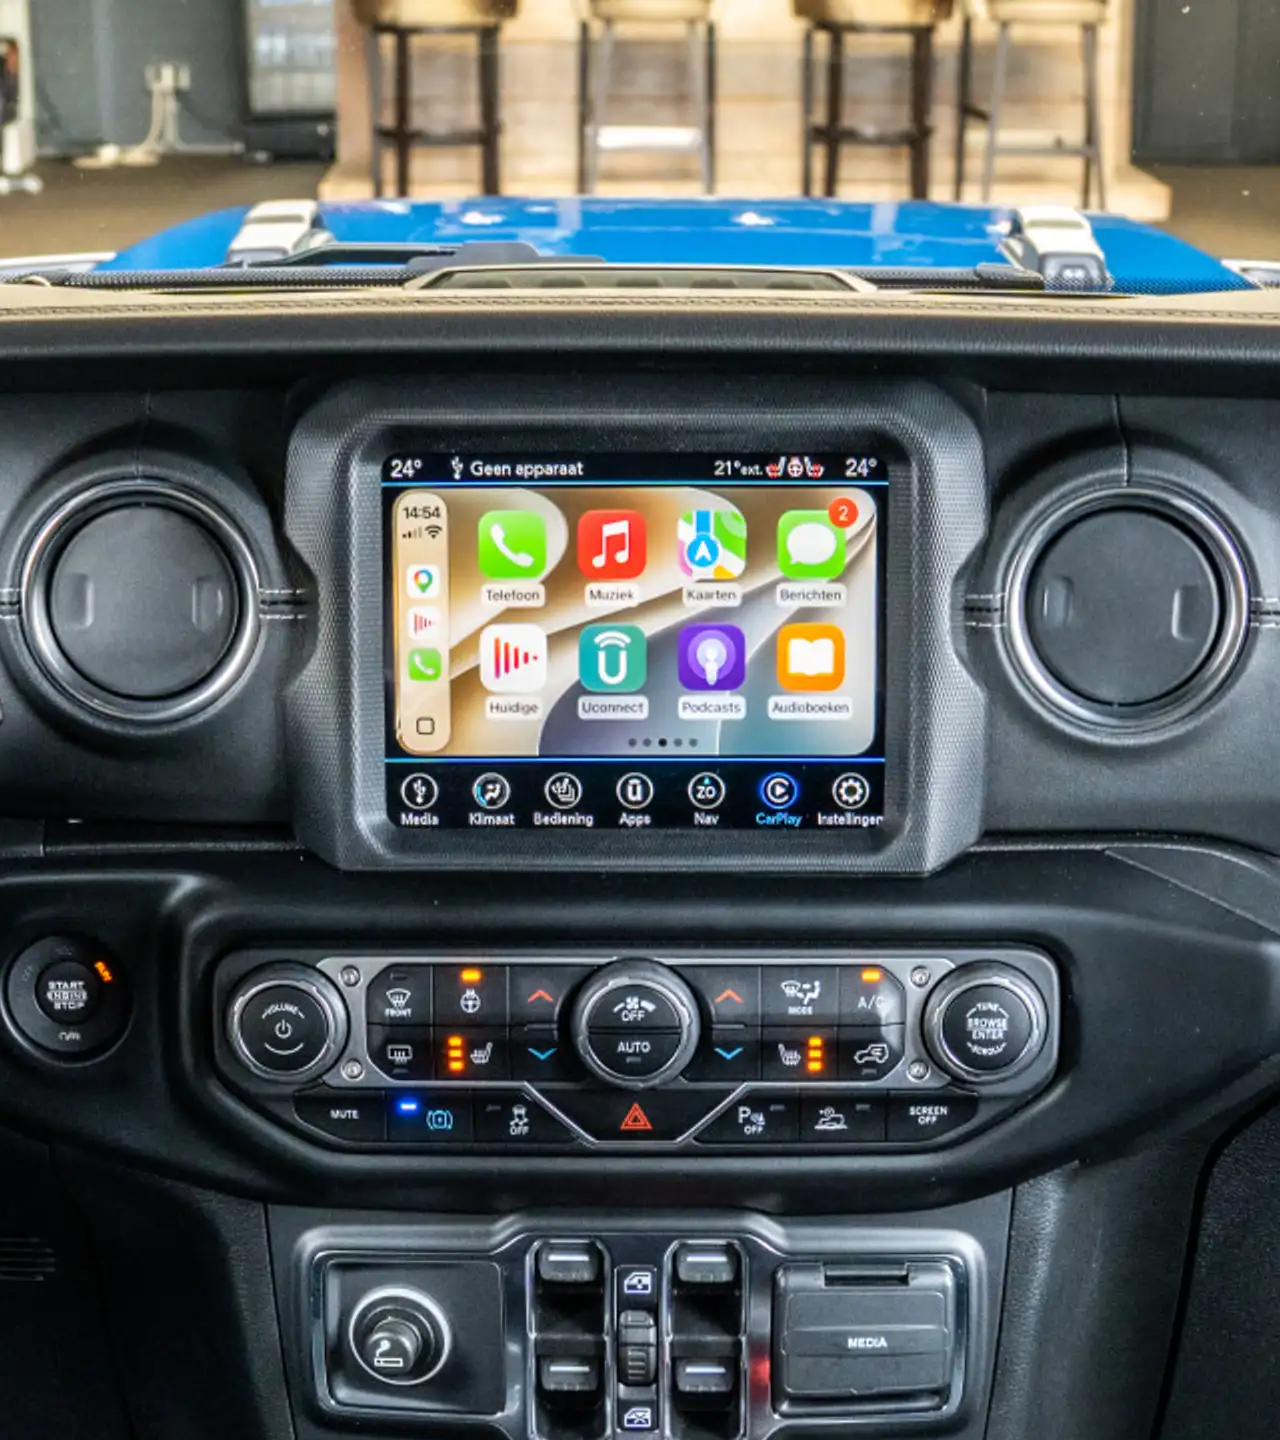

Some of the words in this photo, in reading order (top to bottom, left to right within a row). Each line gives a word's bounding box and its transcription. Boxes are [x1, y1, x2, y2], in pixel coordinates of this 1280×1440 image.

[390, 459, 422, 478] 24°
[470, 461, 511, 476] Geen
[516, 462, 584, 479] apparaat
[845, 458, 877, 477] 24°
[403, 507, 441, 519] 14:54
[838, 506, 849, 521] 2
[486, 590, 539, 601] Telefoon
[589, 590, 635, 601] Muziek
[687, 589, 736, 600] Kaarten
[780, 589, 842, 600] Berichten
[490, 702, 539, 715] Huidige
[582, 702, 644, 713] Uconnect
[683, 702, 741, 713] Podcasts
[772, 702, 849, 713] Audioboeken
[401, 813, 439, 826] Media
[469, 813, 515, 826] Klimaat
[533, 812, 594, 827] Bediening
[619, 813, 651, 827] Apps
[694, 813, 720, 826] Nav
[756, 813, 802, 827] CarPlay
[48, 981, 84, 990] START
[47, 991, 88, 1001] ENGINE
[54, 1002, 85, 1010] STOP
[858, 995, 885, 1009] A/C
[385, 1007, 412, 1017] FRONT
[621, 1010, 645, 1021] OFF
[788, 1006, 813, 1015] MODE
[967, 1018, 1008, 1030] BROWSE
[972, 1030, 1003, 1040] ENTER
[617, 1041, 651, 1053] AUTO
[330, 1109, 359, 1119] MUTE
[909, 1106, 948, 1116] SCREEN
[918, 1116, 937, 1125] OFF
[509, 1125, 529, 1135] OFF
[744, 1126, 763, 1135] OFF
[847, 1336, 887, 1349] MEDIA
